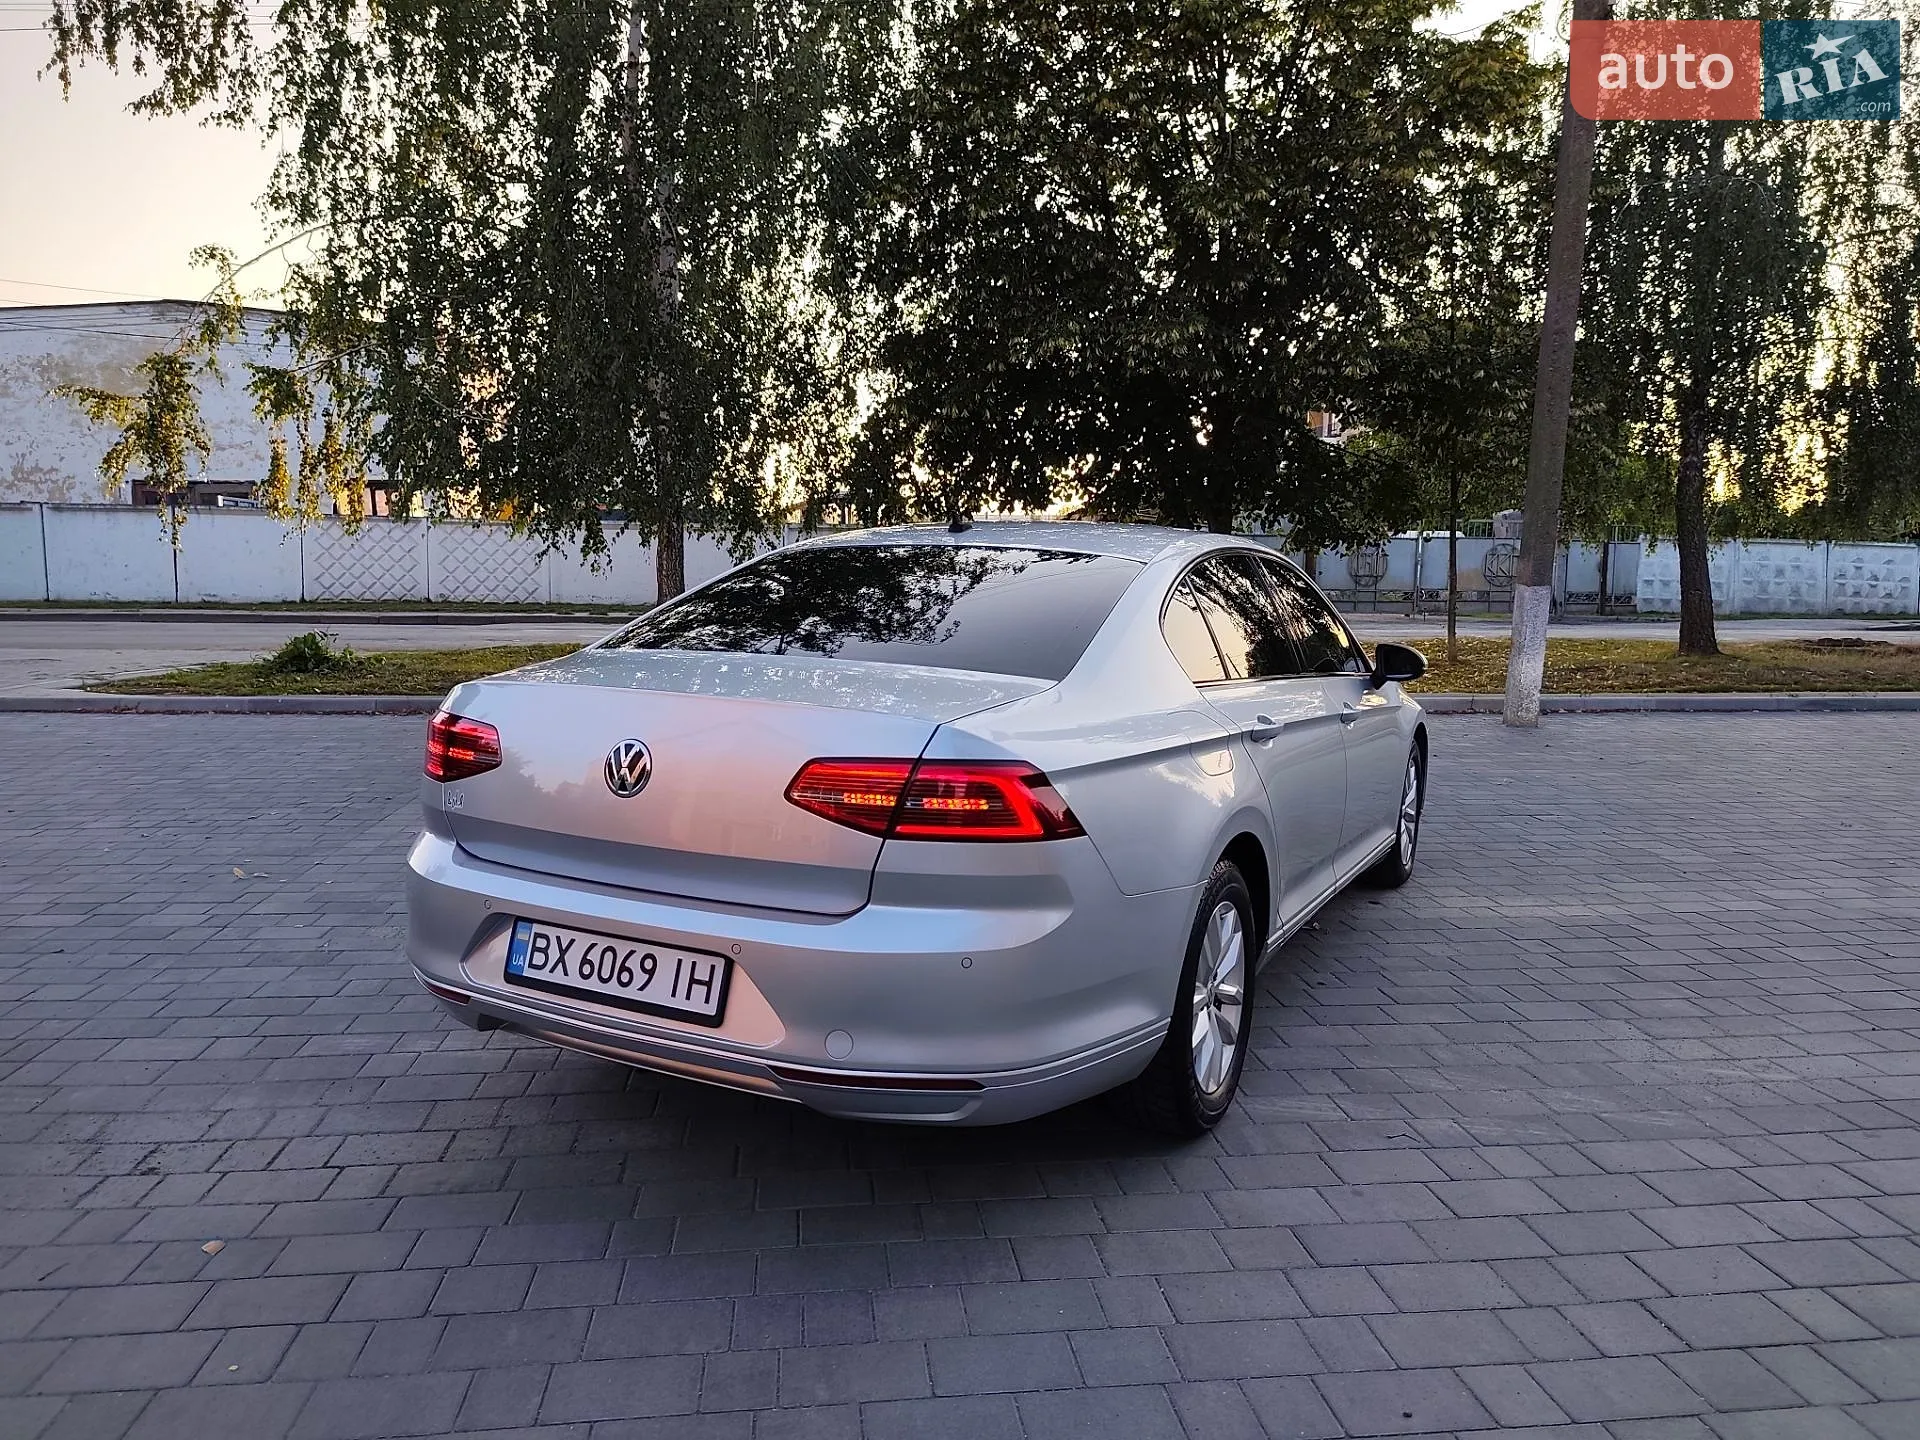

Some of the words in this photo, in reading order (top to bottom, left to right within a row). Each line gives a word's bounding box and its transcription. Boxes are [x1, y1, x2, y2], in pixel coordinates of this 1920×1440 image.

[512, 952, 524, 966] UA
[527, 932, 576, 977] BX
[578, 942, 658, 992] 6069
[670, 958, 716, 1005] IH
